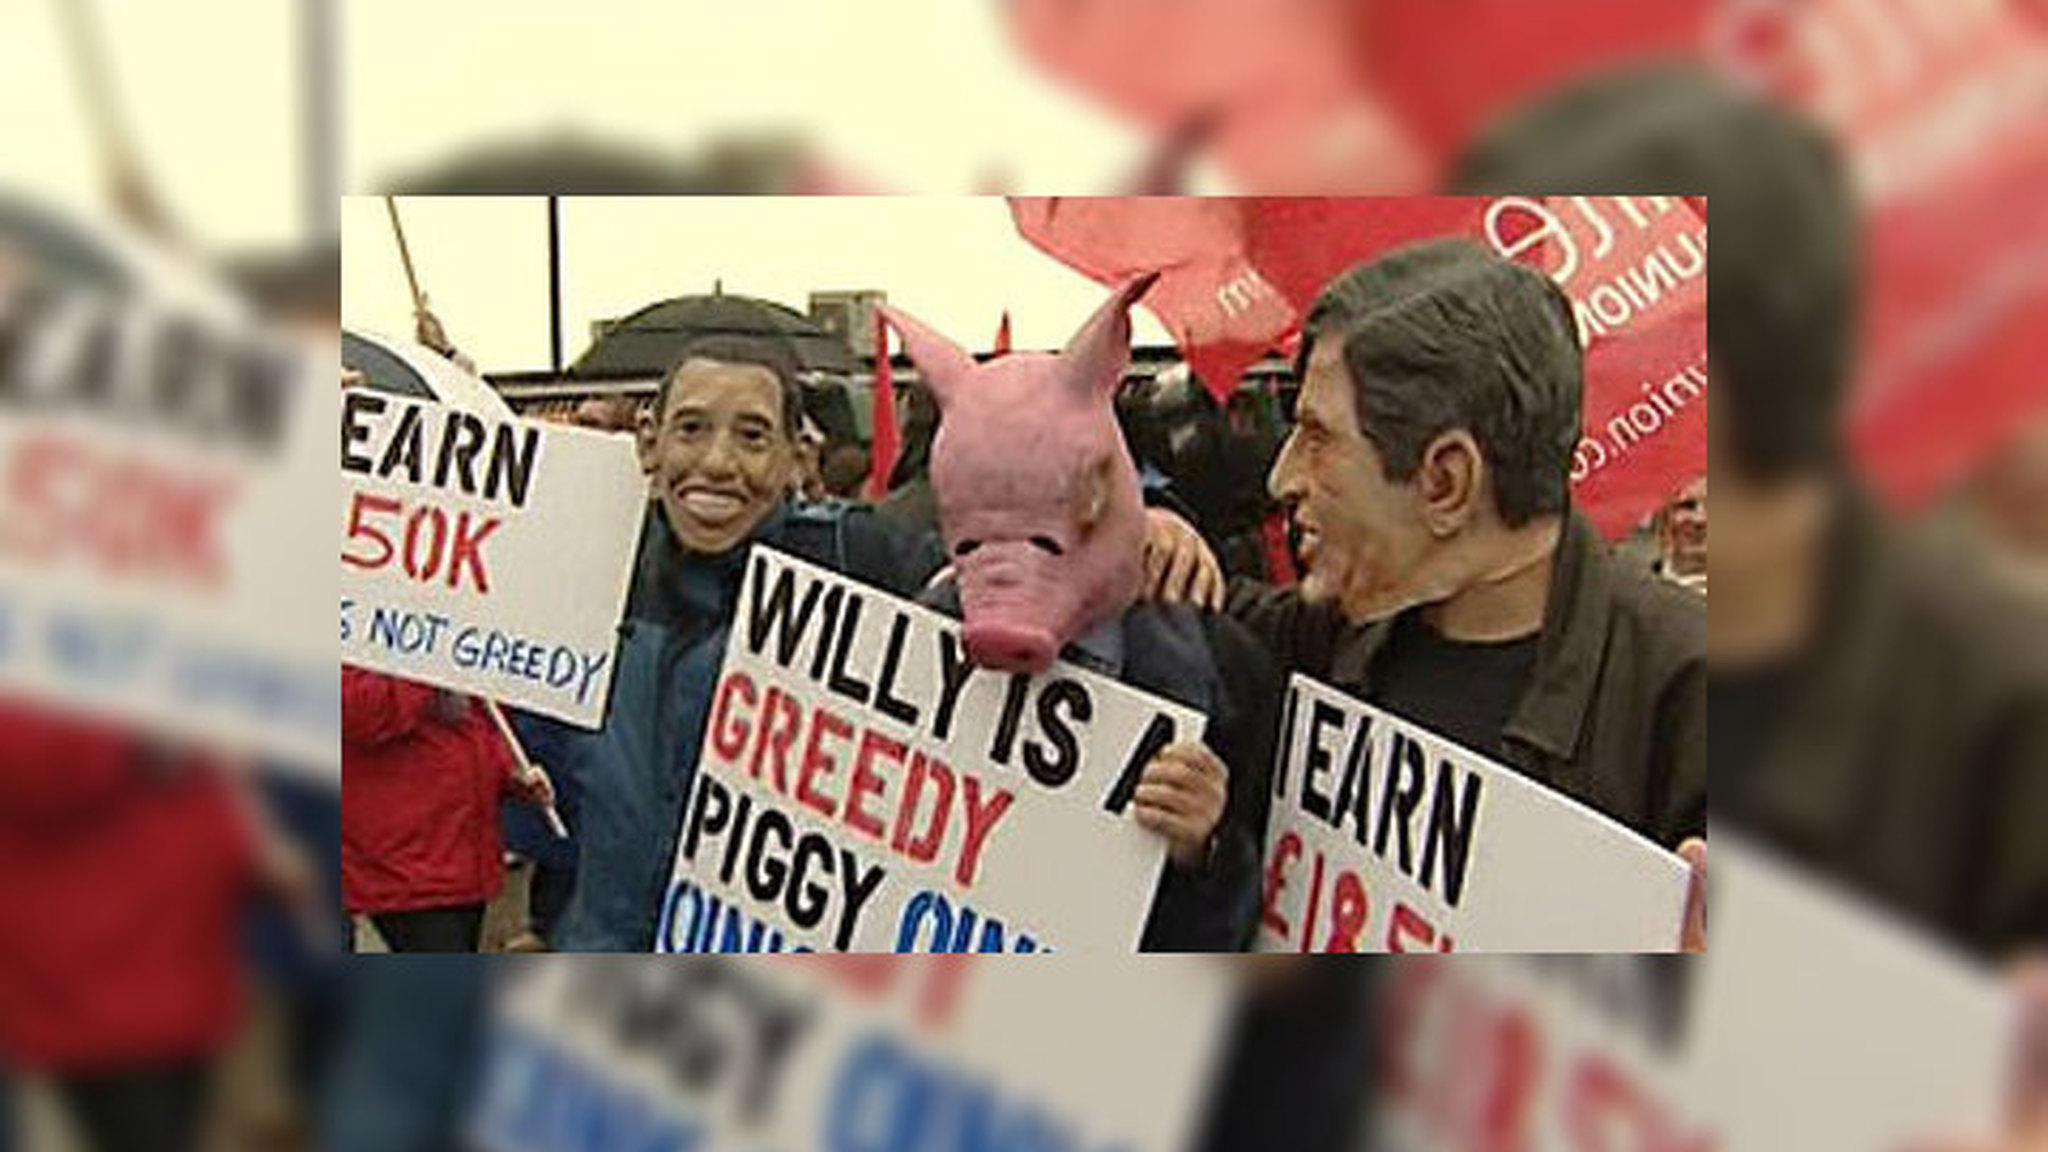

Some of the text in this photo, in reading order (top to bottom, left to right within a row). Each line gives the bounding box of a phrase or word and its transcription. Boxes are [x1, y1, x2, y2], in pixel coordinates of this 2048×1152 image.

[341, 393, 540, 508] EARN
[369, 607, 449, 656] NOT
[455, 627, 607, 703] GREEDY
[746, 554, 979, 740] WILLY
[988, 672, 1093, 789] IS
[682, 773, 886, 953] PIGGY
[711, 671, 1015, 889] GREEDY
[1302, 699, 1483, 909] EARN
